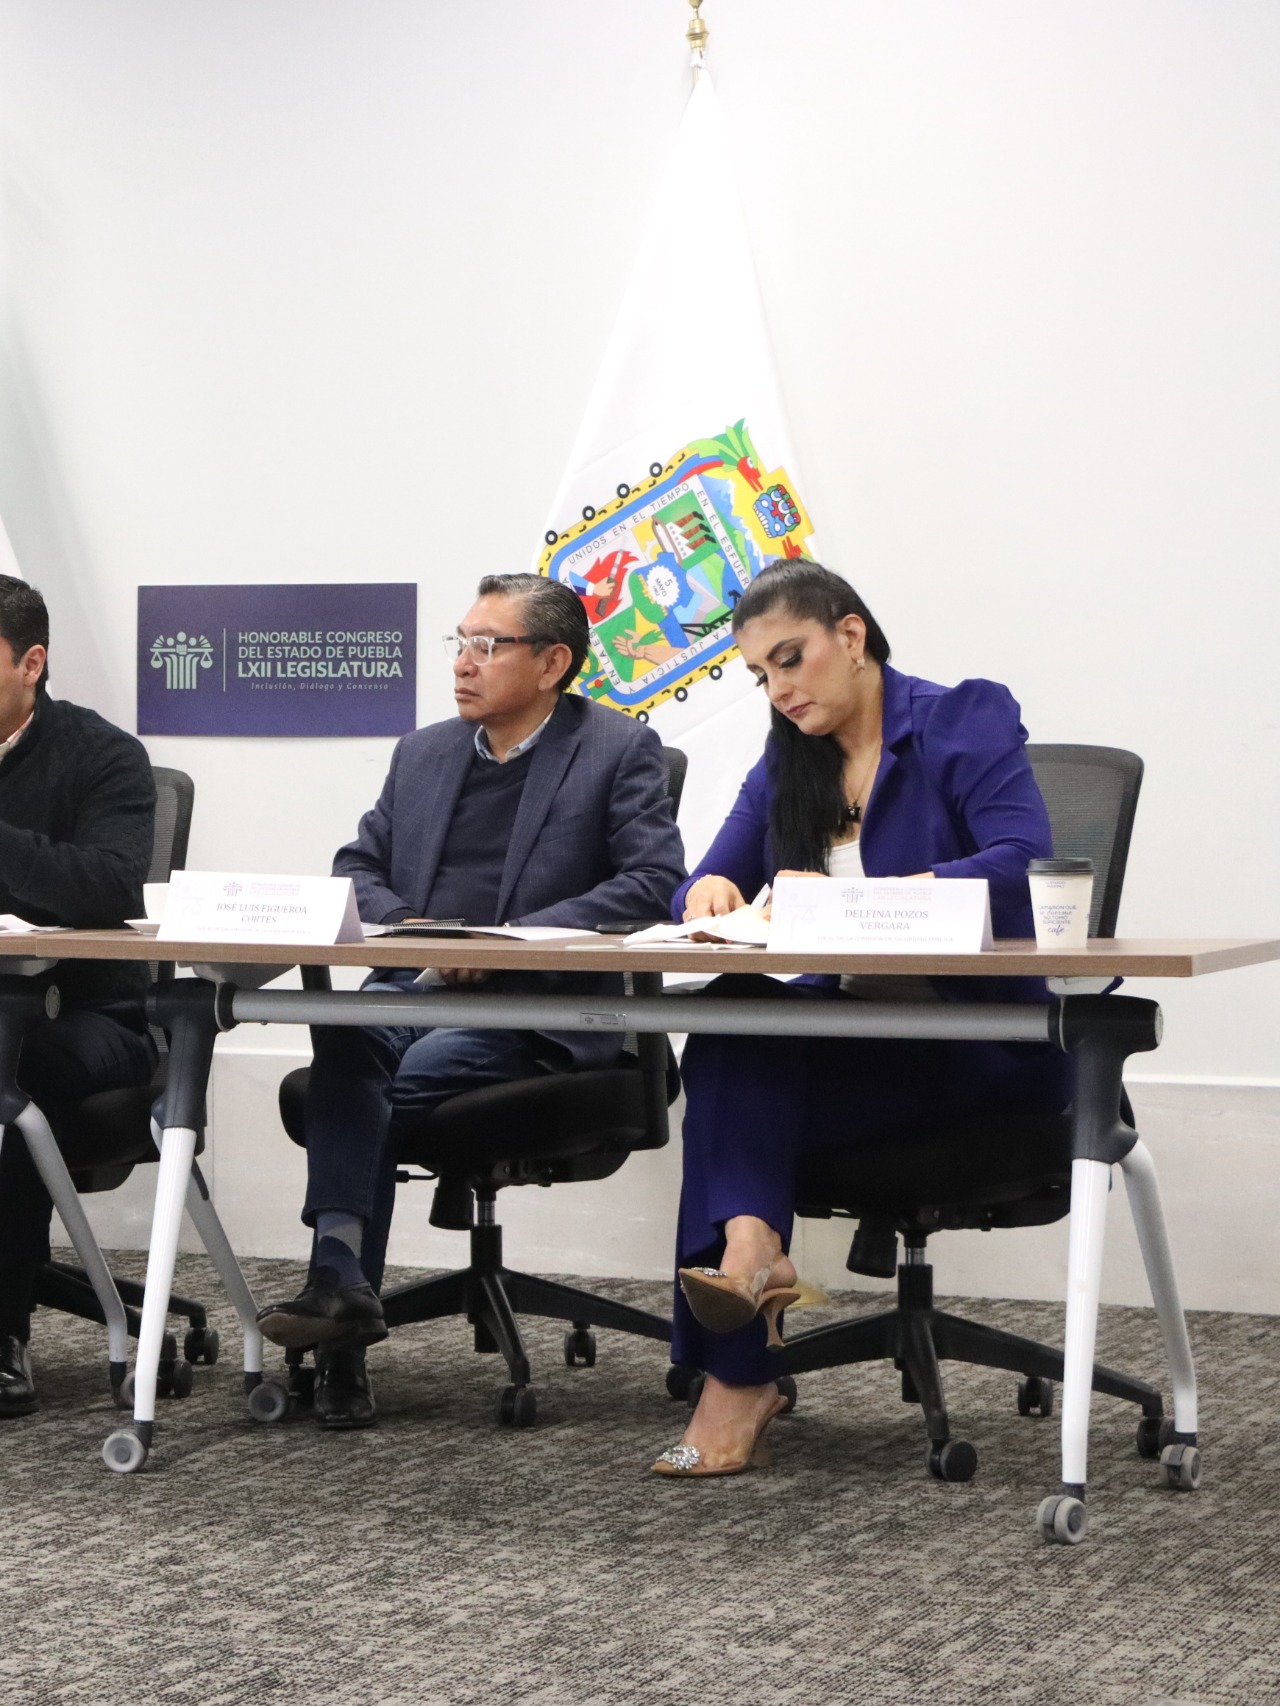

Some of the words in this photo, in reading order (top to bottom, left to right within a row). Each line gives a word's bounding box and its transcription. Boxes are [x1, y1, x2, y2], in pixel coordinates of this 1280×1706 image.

[568, 536, 607, 565] UNIDOS
[612, 524, 627, 536] EN
[632, 512, 646, 524] EL
[650, 482, 690, 511] TIEMPO
[696, 490, 709, 507] EN
[709, 513, 720, 530] EL
[720, 536, 750, 586] ESFUER
[238, 631, 322, 644] HONORABLE
[326, 631, 403, 644] CONGRESO
[238, 646, 263, 658] DEL
[267, 646, 321, 659] ESTADO
[326, 646, 344, 658] DE
[348, 646, 403, 658] PUEBLA
[641, 641, 704, 684] JUSTICIA
[238, 662, 271, 678] LXII
[276, 661, 403, 678] LEGISLATURA
[346, 682, 389, 690] Consenso
[216, 902, 237, 912] JOSÉ
[239, 904, 260, 913] LUIS
[261, 905, 307, 914] FIGUEROA
[844, 909, 891, 919] DELFINA
[894, 910, 929, 919] POZOS
[860, 921, 910, 931] VERGARA
